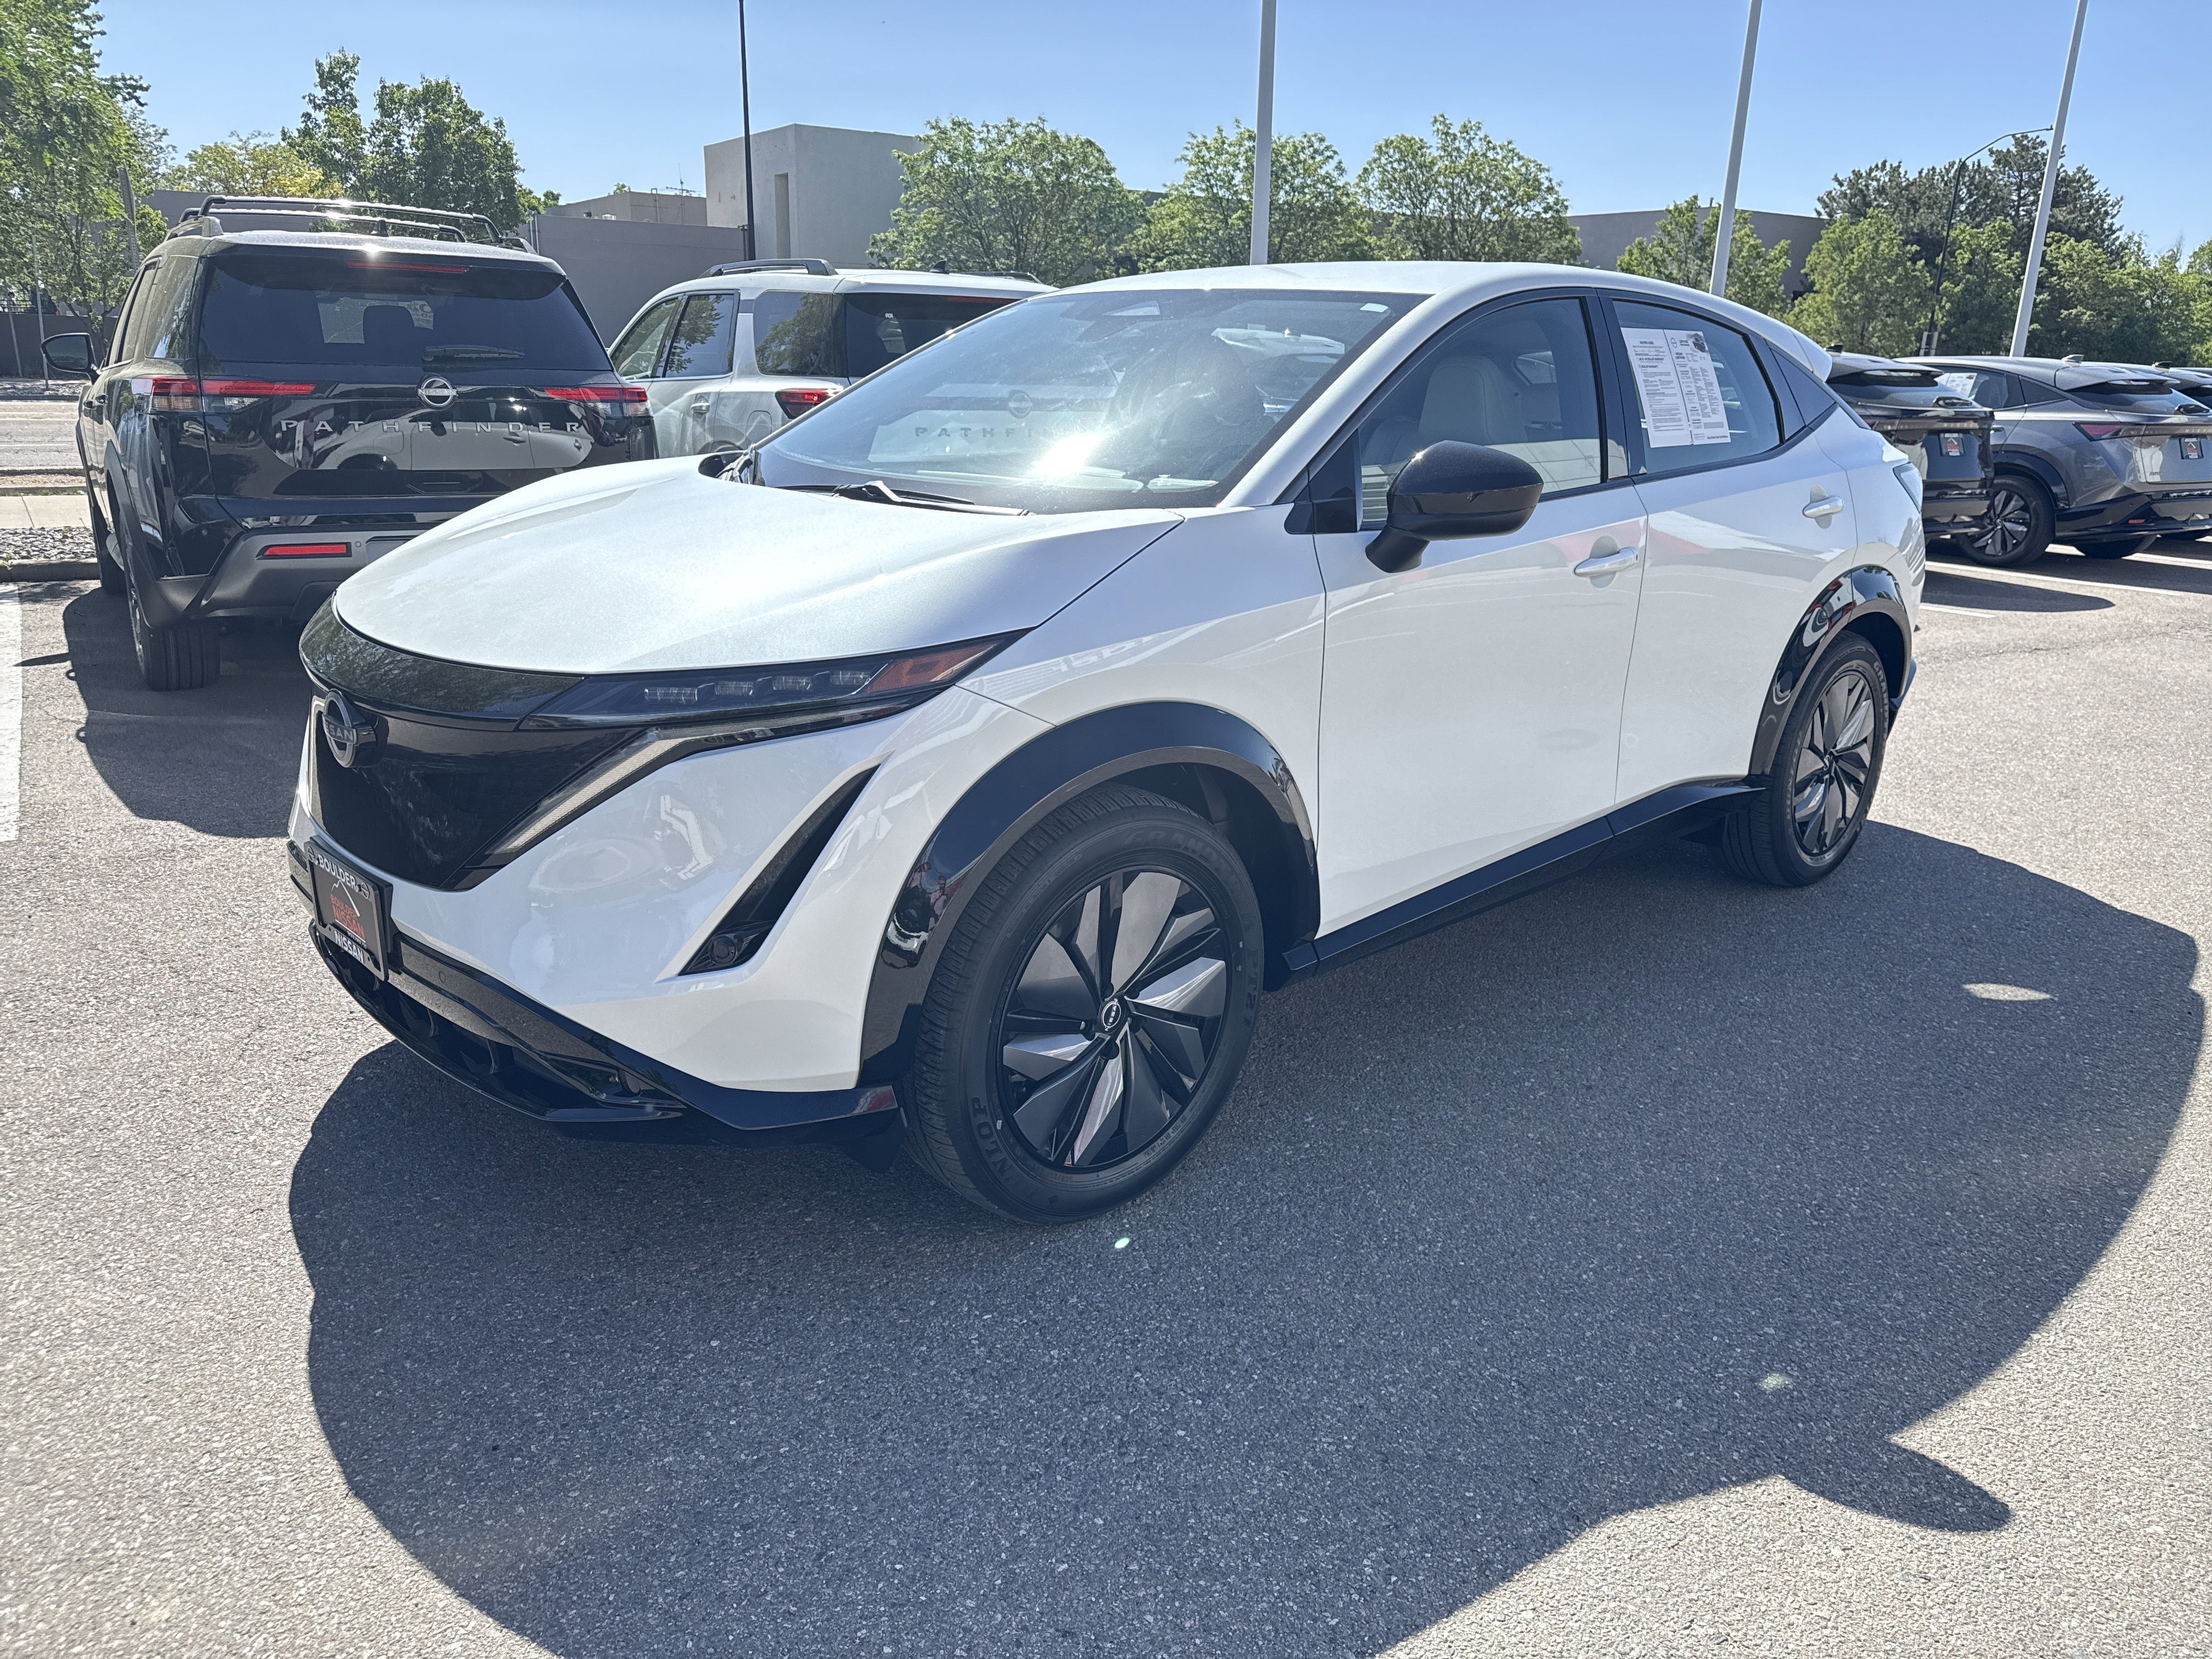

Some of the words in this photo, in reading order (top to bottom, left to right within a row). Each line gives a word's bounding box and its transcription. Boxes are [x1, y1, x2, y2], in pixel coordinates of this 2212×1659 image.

[280, 420, 581, 433] PATHFINDER
[318, 854, 356, 890] BOULDER
[330, 893, 357, 919] BOULDER
[332, 904, 365, 940] NISSAN
[334, 930, 364, 964] NISSAN
[1104, 998, 1119, 1031] NISSAN
[971, 1097, 1037, 1198] DUNLOP
